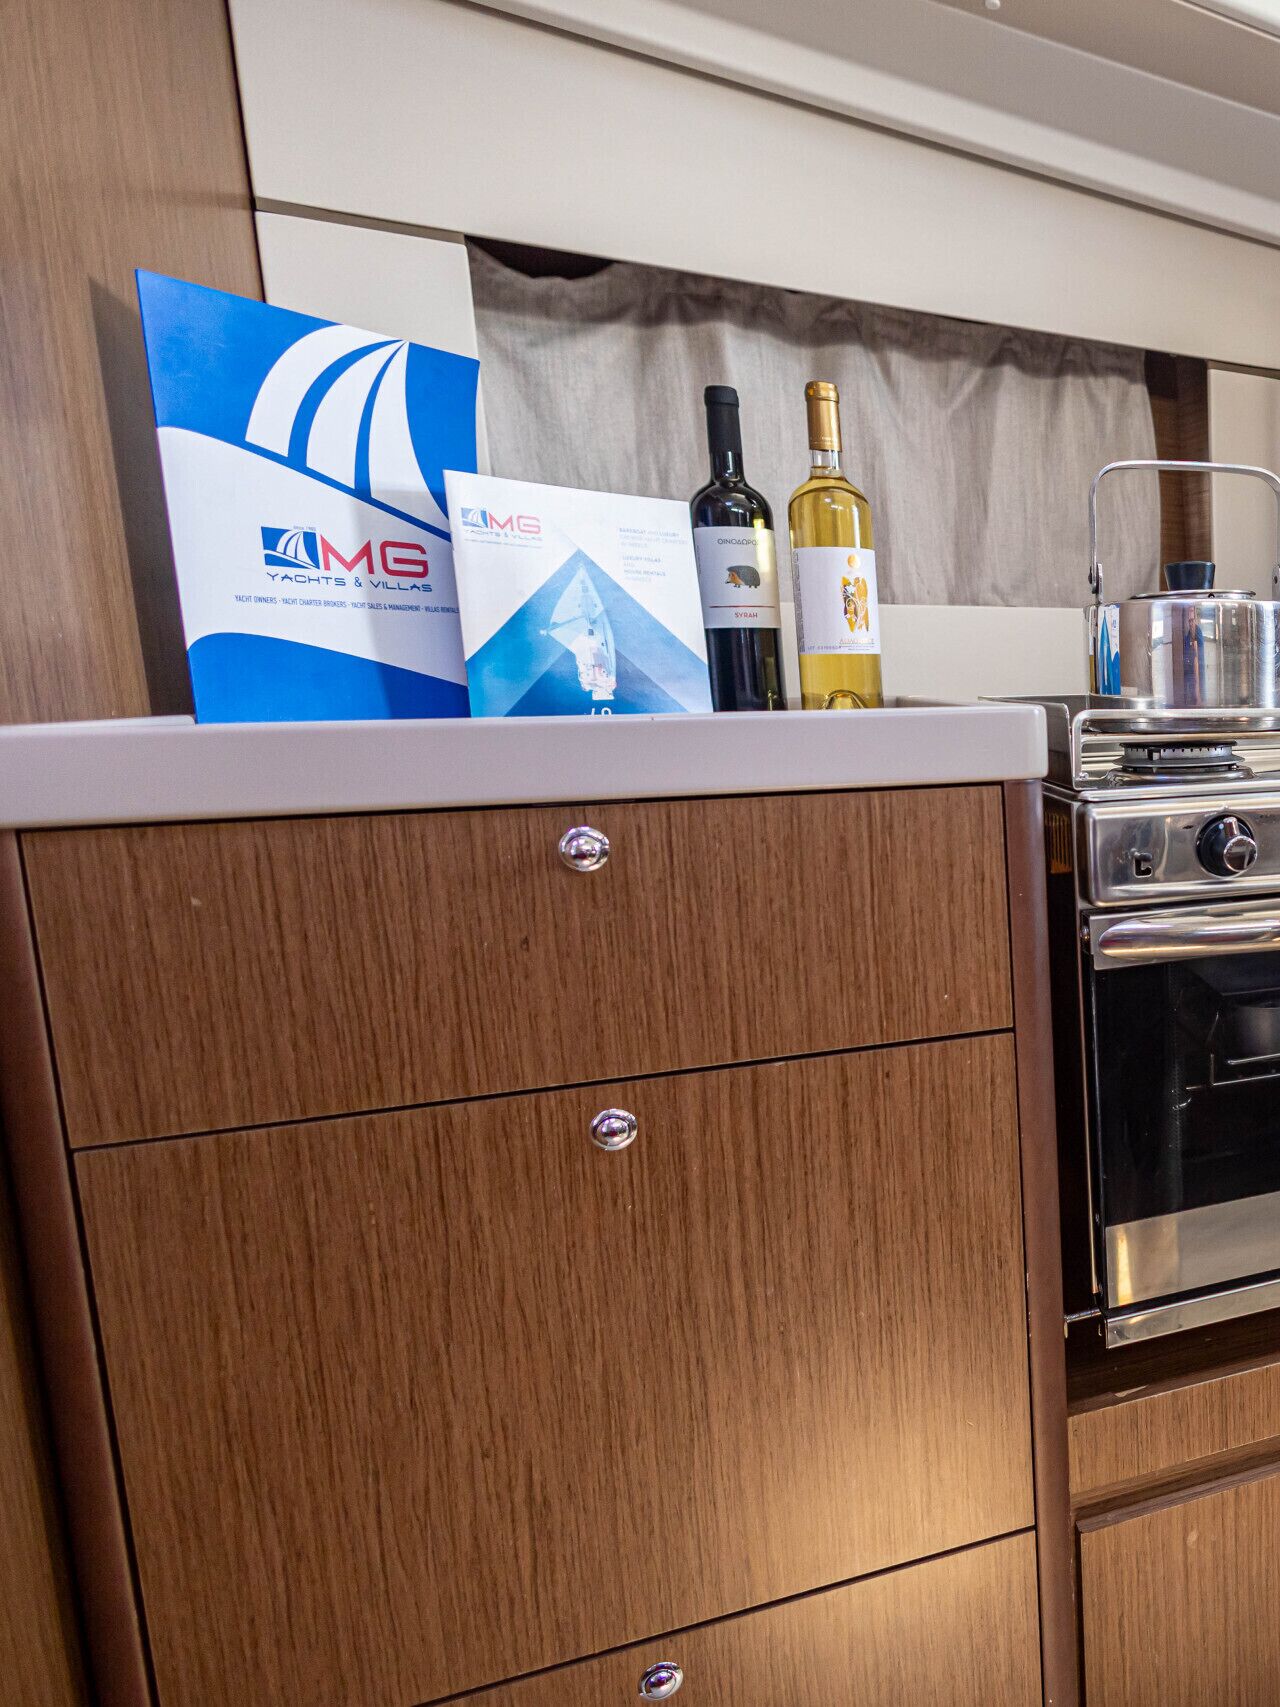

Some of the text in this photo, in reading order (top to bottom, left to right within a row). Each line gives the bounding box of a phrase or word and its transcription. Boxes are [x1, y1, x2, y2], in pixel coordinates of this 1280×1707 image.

[266, 572, 433, 592] YACHTS & VILLAS
[234, 595, 252, 603] YACHT
[253, 596, 277, 605] OWNERS
[281, 597, 298, 605] YACHT
[299, 598, 321, 607] CHARTER
[323, 600, 347, 608] BROKERS
[351, 601, 366, 609] YACHT
[367, 602, 383, 610] SALES
[388, 603, 421, 612] MANAGEMENT
[424, 605, 440, 613] VILLAS
